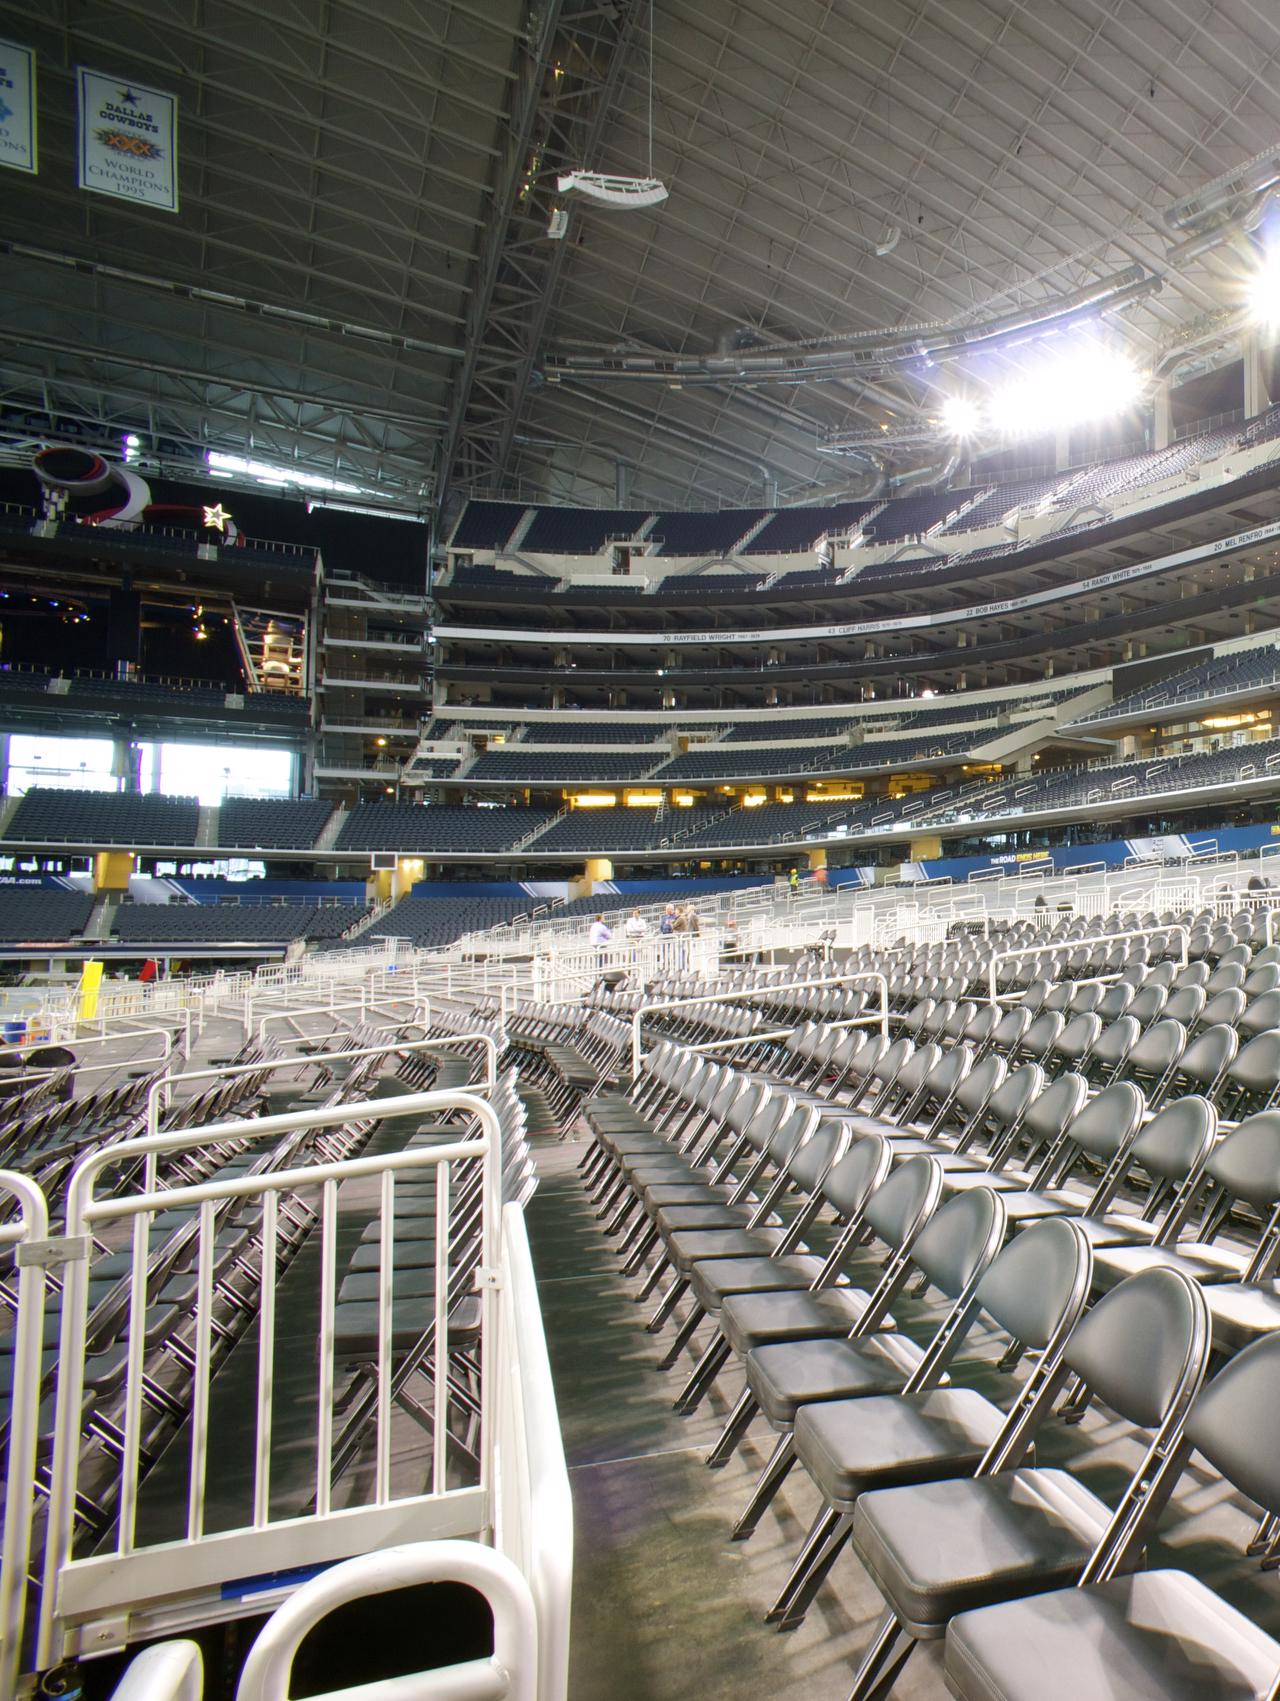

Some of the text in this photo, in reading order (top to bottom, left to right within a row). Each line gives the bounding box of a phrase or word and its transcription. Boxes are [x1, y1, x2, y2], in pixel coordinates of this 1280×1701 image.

[100, 110, 159, 133] COWBOYS
[105, 102, 153, 122] DALLAS
[88, 164, 170, 193] CHAMPIONS
[105, 158, 155, 179] WORLD
[116, 183, 145, 197] 1995
[1214, 543, 1222, 551] 20
[1225, 538, 1237, 547] MEL
[1238, 529, 1263, 544] RENFRO
[1082, 581, 1090, 590] 54
[1091, 575, 1110, 587] RANDY
[1112, 569, 1130, 581] WHITE
[975, 606, 988, 615] BOB
[990, 602, 1009, 612] HAYES
[838, 626, 856, 634] CLIFF
[857, 623, 881, 632] HARRIS
[1000, 855, 1016, 863] ROAD
[1016, 853, 1032, 862] ENDS
[1033, 851, 1050, 860] HERE
[0, 876, 42, 885] AA.com
